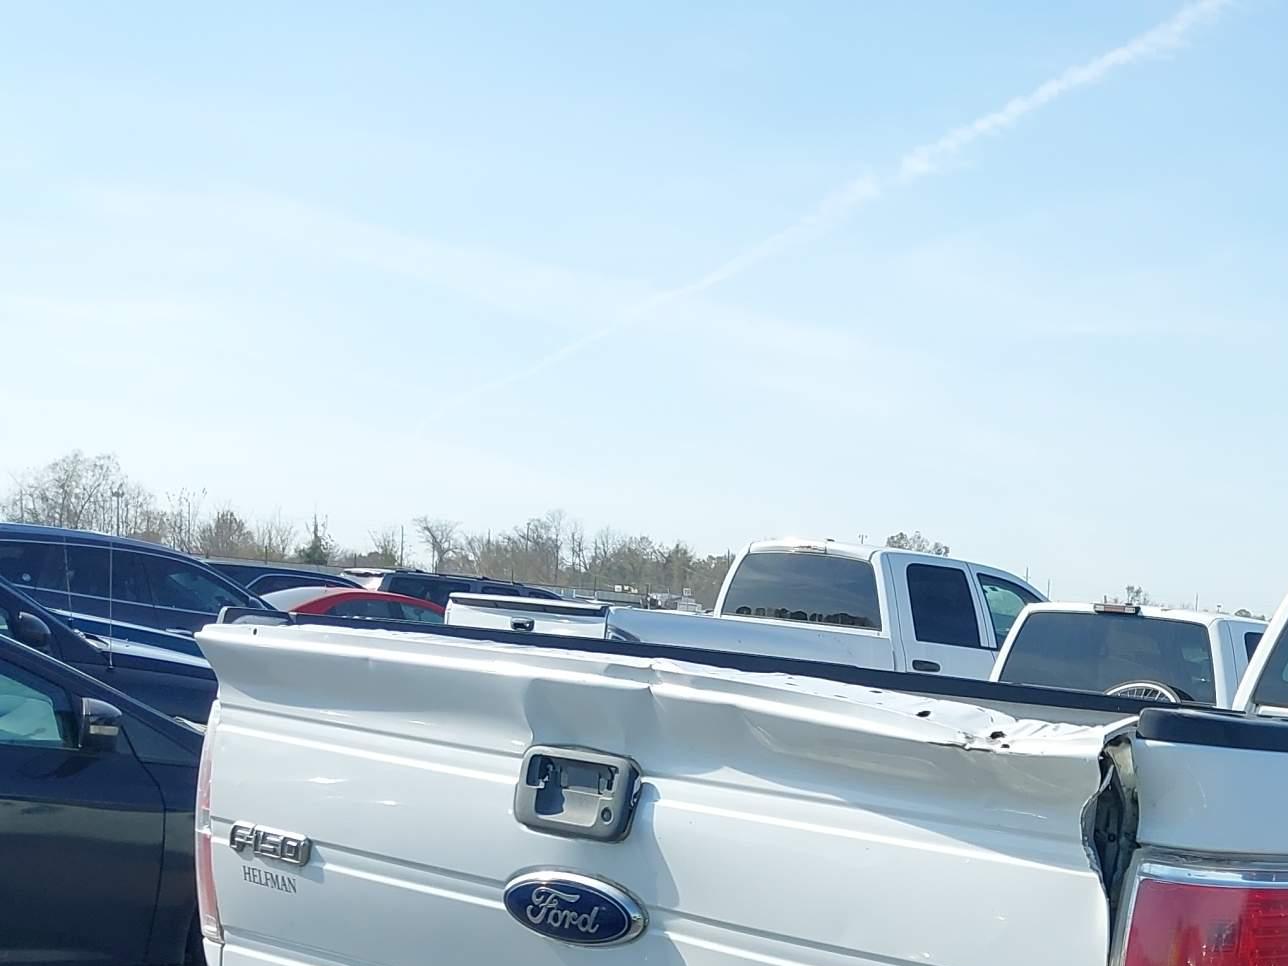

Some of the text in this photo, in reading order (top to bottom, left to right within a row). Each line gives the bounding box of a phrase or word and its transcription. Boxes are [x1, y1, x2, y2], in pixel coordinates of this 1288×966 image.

[229, 821, 312, 867] F-150
[242, 865, 297, 894] HELFMAN
[526, 886, 600, 933] Ford
